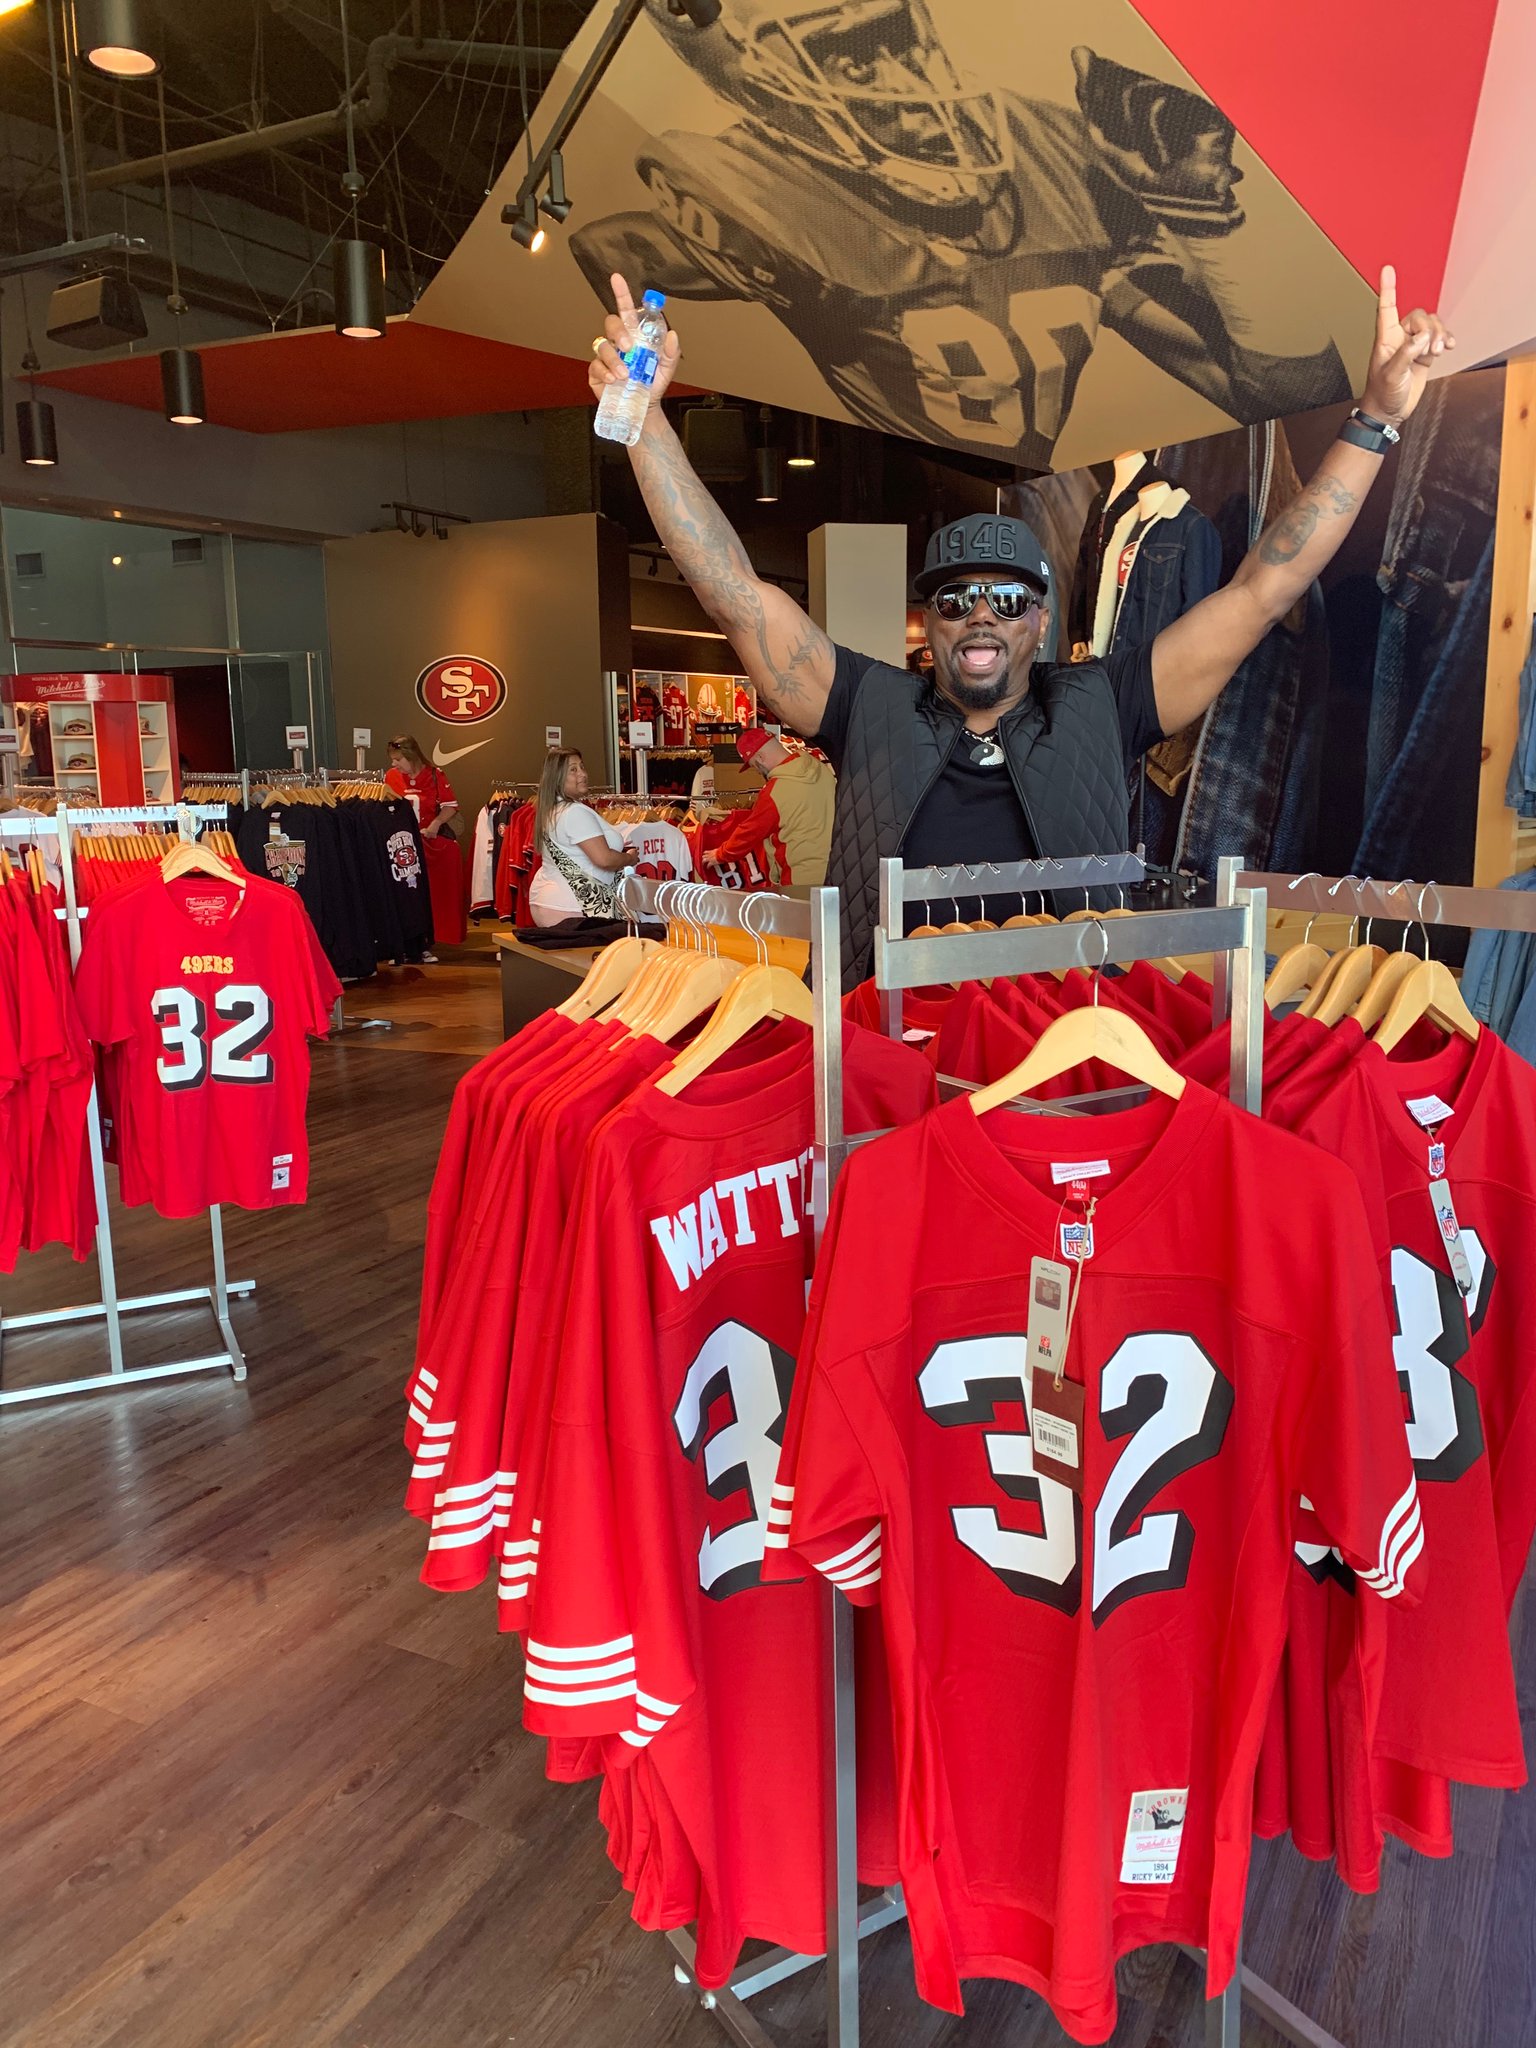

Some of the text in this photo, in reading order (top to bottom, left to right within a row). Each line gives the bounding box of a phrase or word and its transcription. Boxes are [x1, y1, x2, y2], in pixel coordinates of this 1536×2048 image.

[936, 522, 1017, 562] 1946
[643, 838, 665, 856] RICE
[180, 955, 234, 974] 49ERS
[150, 984, 275, 1092] 32
[650, 1146, 813, 1293] WATT
[916, 1331, 1236, 1630] 32
[1131, 1873, 1153, 1882] RICKY
[1153, 1863, 1169, 1872] 1994
